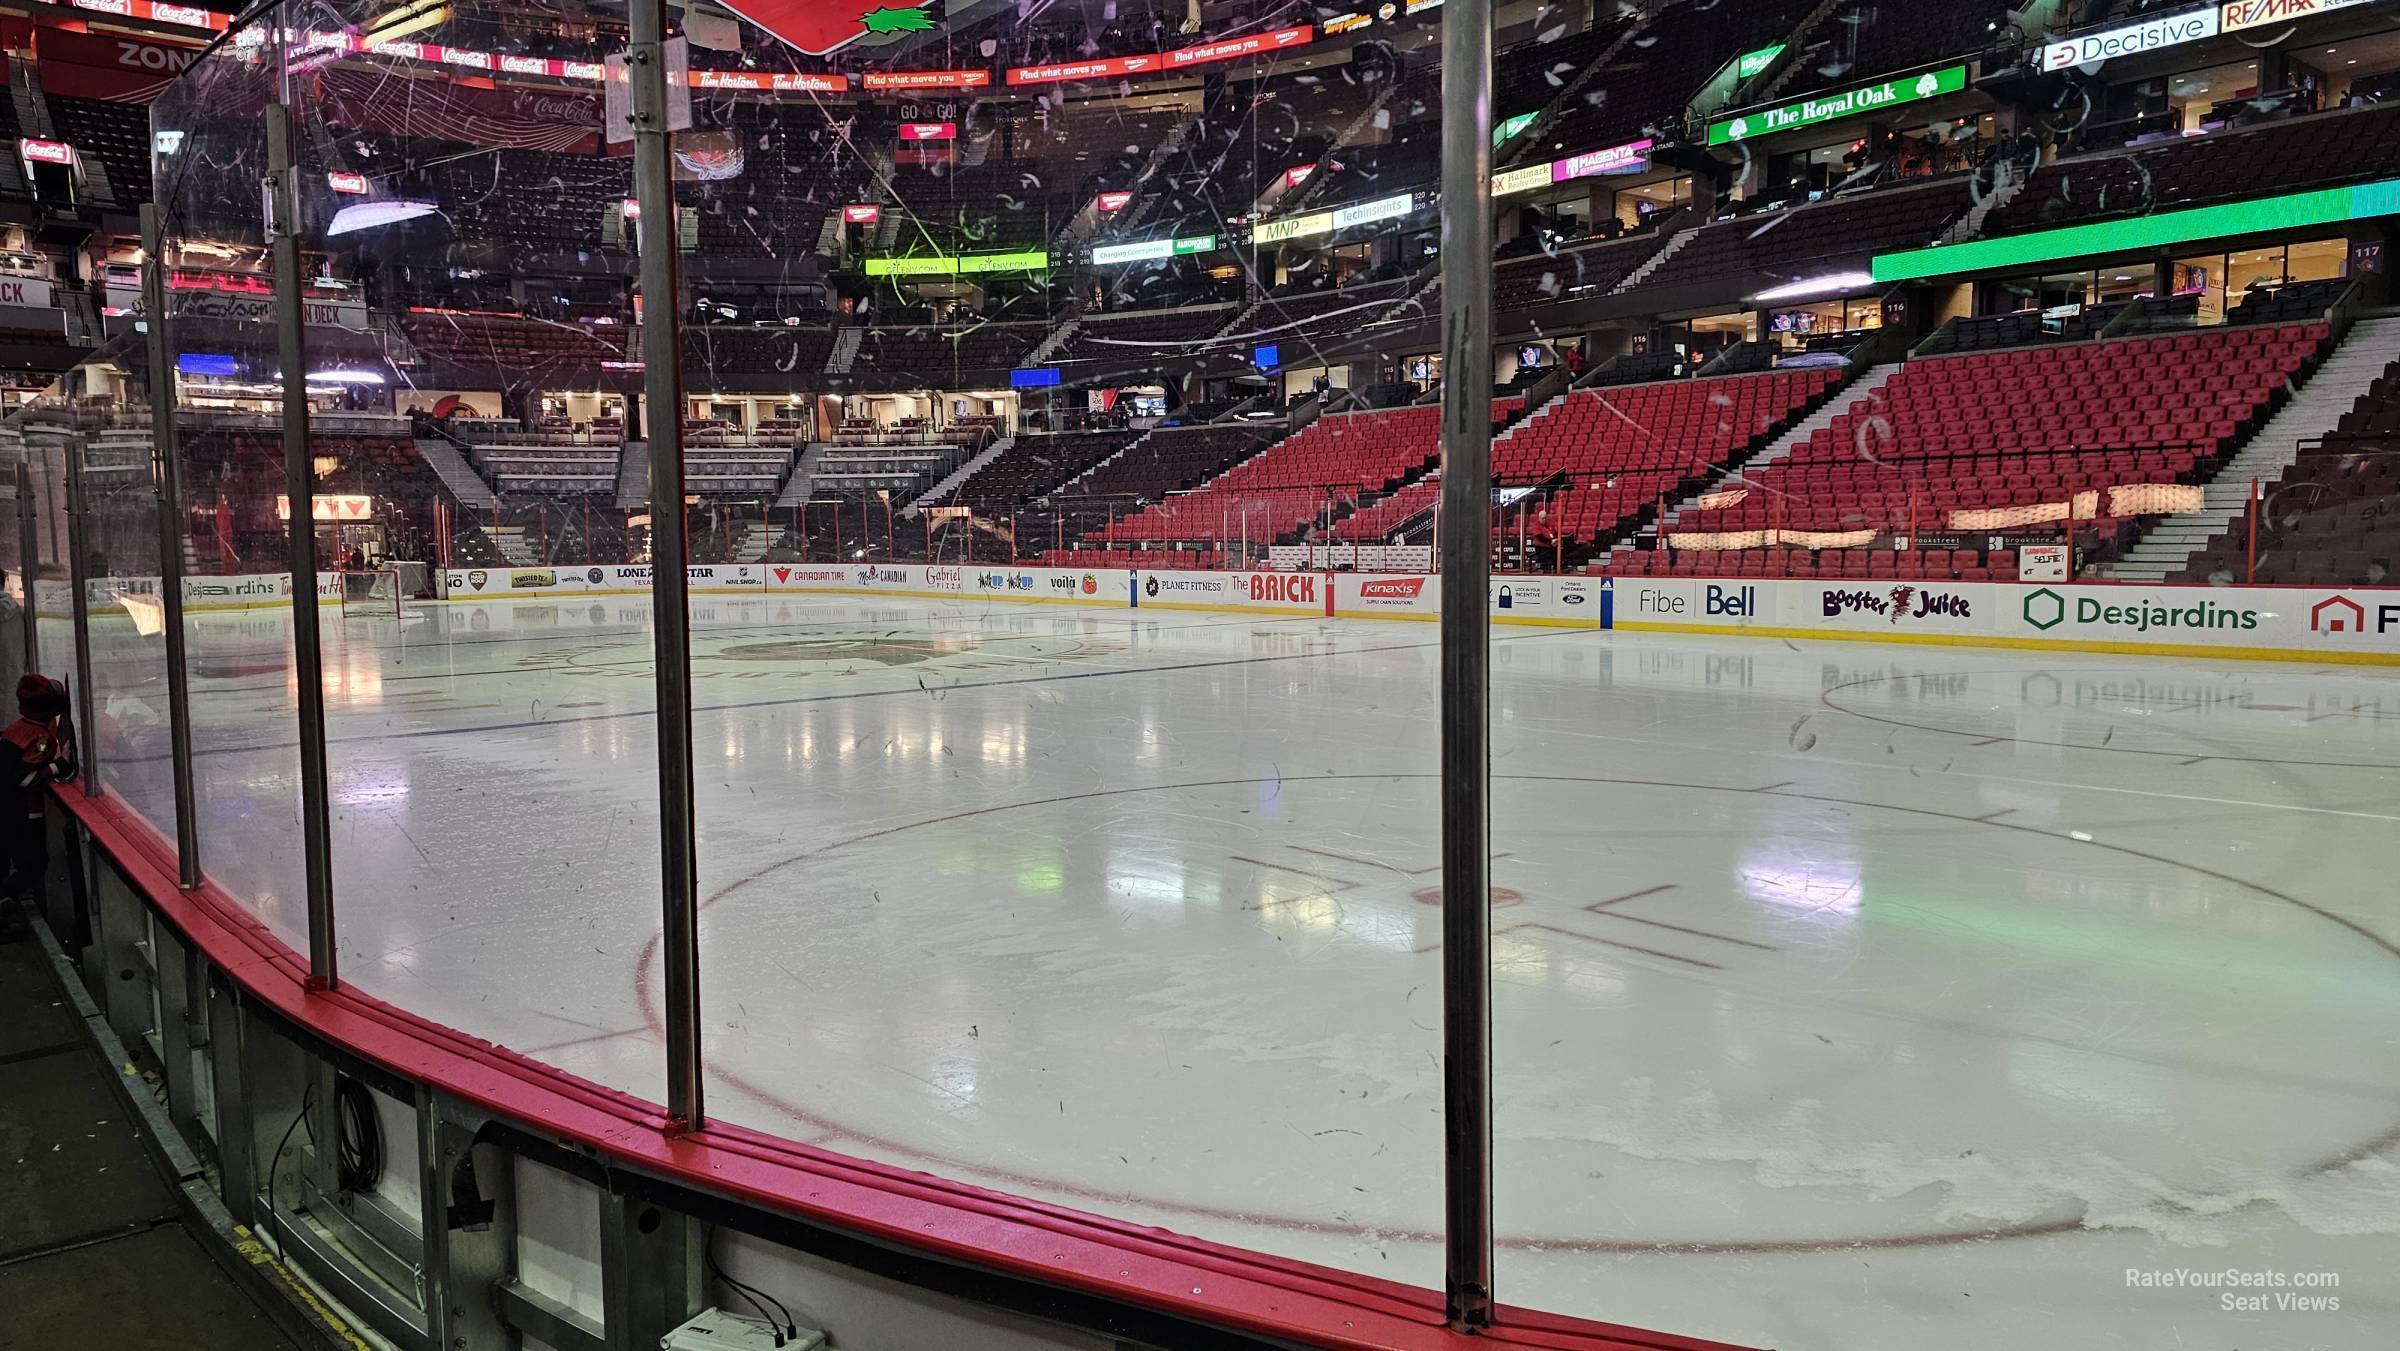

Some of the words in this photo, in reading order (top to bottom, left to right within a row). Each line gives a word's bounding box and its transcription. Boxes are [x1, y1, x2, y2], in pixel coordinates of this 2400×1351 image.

[2082, 19, 2204, 61] Decisive
[118, 41, 197, 71] ZON
[1175, 51, 1192, 61] Find
[1194, 49, 1214, 60] what
[1215, 45, 1240, 57] moves
[1242, 40, 1258, 52] you
[867, 75, 886, 85] Find
[888, 75, 908, 85] what
[911, 75, 937, 84] moves
[938, 74, 954, 85] you
[1020, 68, 1038, 80] Find
[1040, 68, 1061, 79] what
[1063, 66, 1088, 77] moves
[1091, 64, 1107, 76] you
[701, 72, 719, 88] Tim
[720, 73, 759, 89] Hortons
[772, 74, 793, 89] Tim
[793, 74, 833, 90] Hortons
[901, 105, 918, 119] GO
[937, 104, 957, 119] GO!
[1764, 108, 1798, 128] The
[1801, 91, 1852, 120] Royal
[1856, 83, 1896, 107] Oak
[1580, 146, 1634, 166] MAGENTA
[1508, 165, 1549, 181] Hallmark
[1415, 191, 1426, 200] 320
[1342, 199, 1402, 221] TechInsights
[1415, 202, 1426, 211] 220
[1266, 221, 1300, 240] MNP
[2356, 245, 2380, 257] 117
[315, 305, 340, 324] DECK
[1888, 304, 1904, 312] 116
[1633, 336, 1647, 344] 116
[1384, 366, 1394, 374] 115
[617, 568, 649, 578] LONE
[687, 568, 714, 578] STAR
[794, 571, 829, 581] CANADIAN
[832, 571, 846, 581] TIRE
[880, 570, 907, 583] CANADIAN
[926, 566, 961, 584] Gabriel
[937, 582, 962, 590] PIZZA
[1050, 575, 1076, 588] voilà
[1162, 581, 1189, 591] PLANET
[1191, 581, 1222, 592] FITNESS
[1232, 575, 1248, 591] The
[1250, 574, 1315, 603] BRICK
[1639, 589, 1685, 614] Fibe
[1706, 584, 1754, 617] Bell
[1822, 589, 1889, 617] Booster
[1913, 590, 1971, 618] Juice
[2076, 597, 2258, 632] Desjardins
